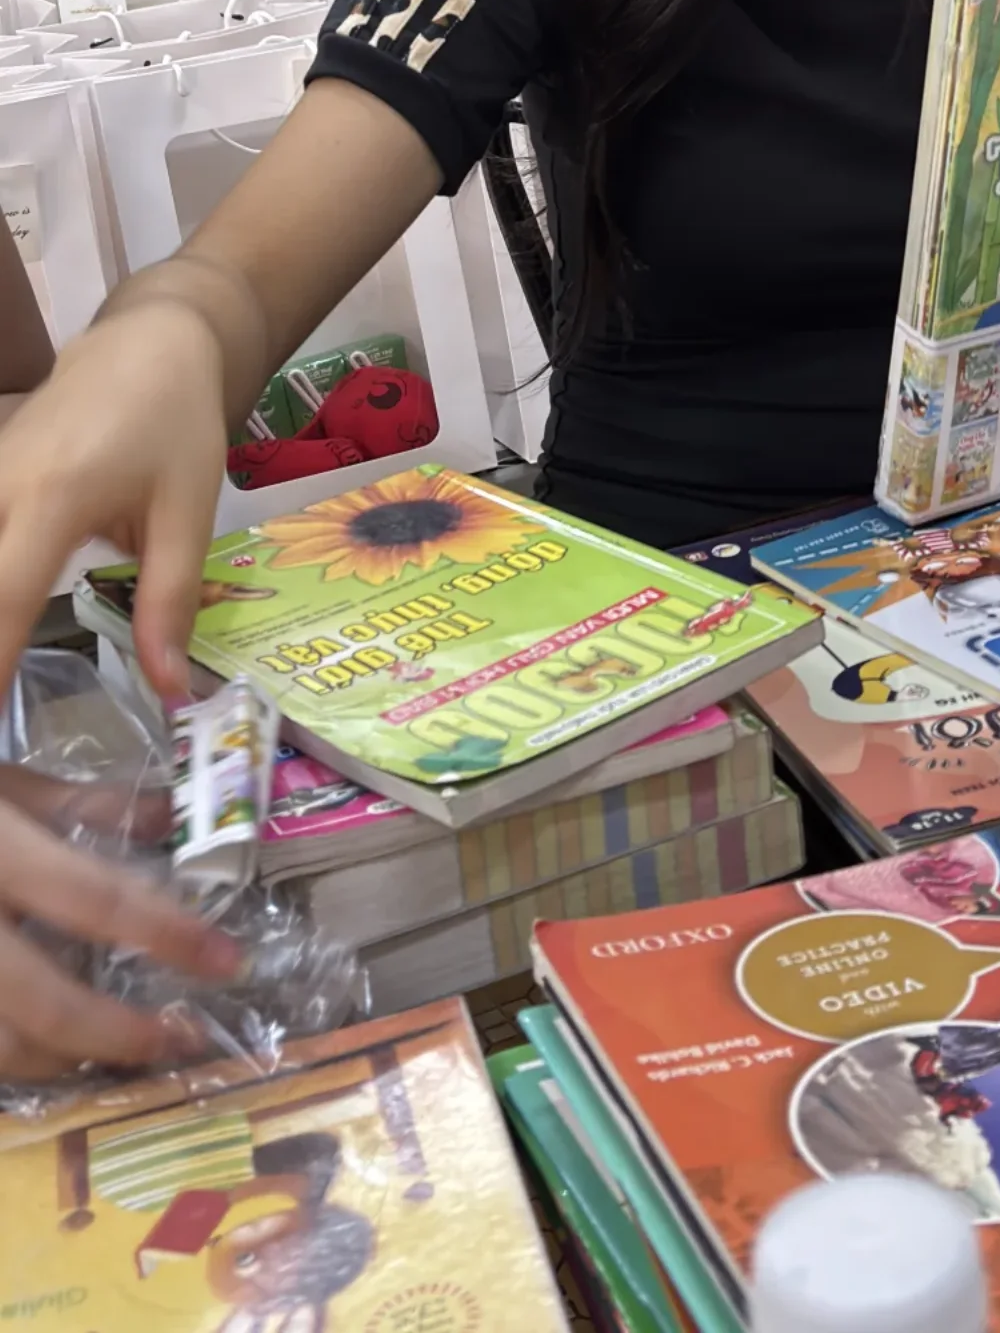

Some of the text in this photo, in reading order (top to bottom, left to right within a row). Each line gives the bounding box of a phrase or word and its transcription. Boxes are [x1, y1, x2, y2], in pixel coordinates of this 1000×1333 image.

[340, 594, 455, 647] thực
[395, 610, 492, 661] Thế
[257, 636, 341, 677] vật
[291, 639, 396, 695] giới
[590, 922, 734, 958] OXFORD
[776, 929, 891, 968] PRACTICE
[799, 947, 889, 978] ONLINE
[818, 976, 926, 1012] VIDEO
[863, 998, 901, 1017] with
[708, 1033, 761, 1055] David
[648, 1044, 794, 1084] Jack C. Richards
